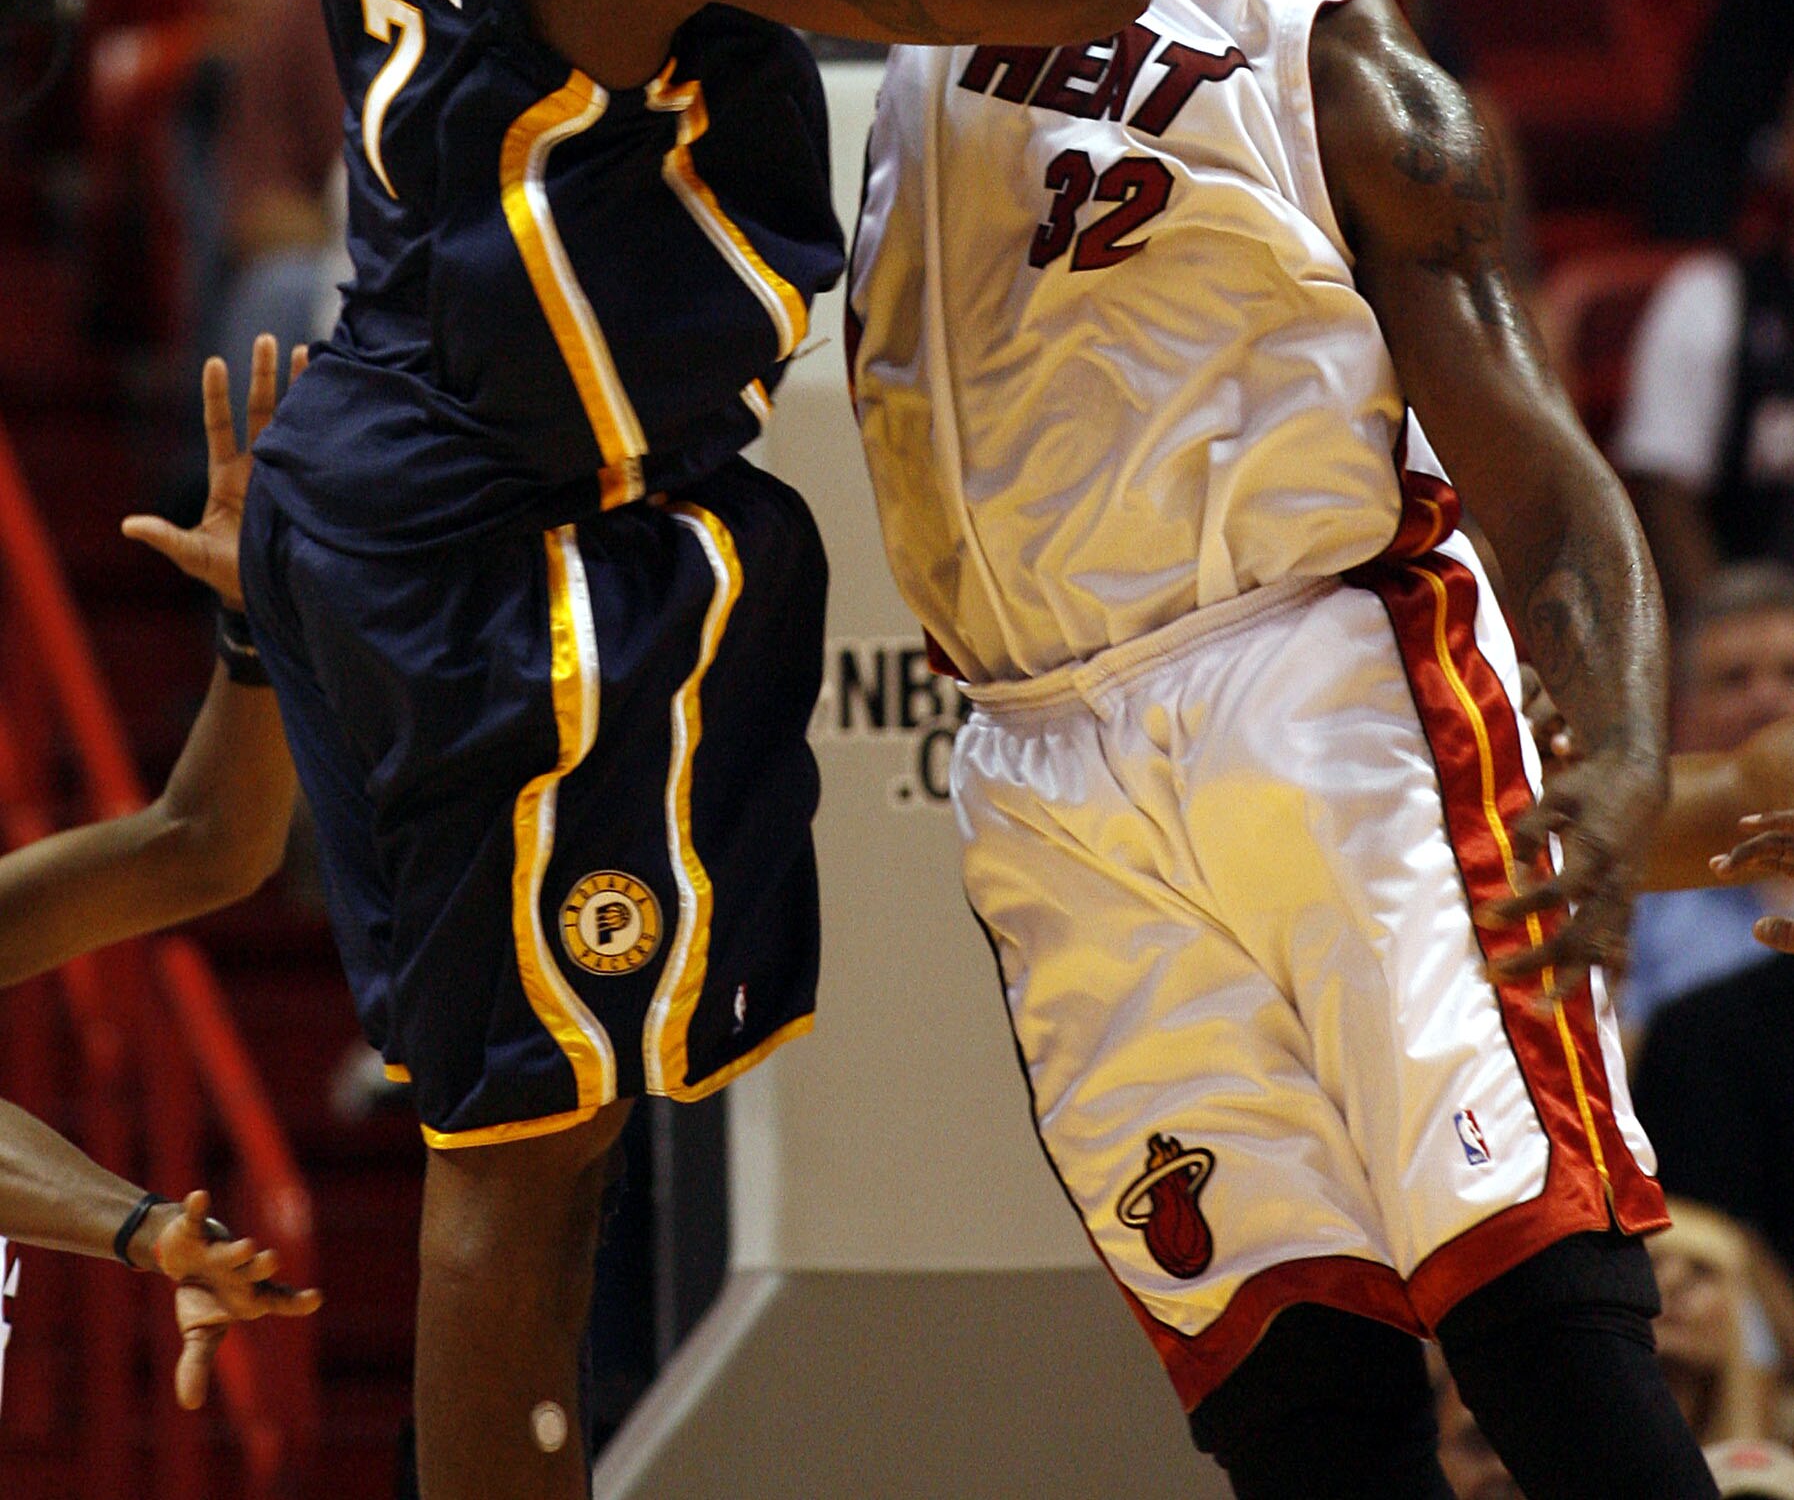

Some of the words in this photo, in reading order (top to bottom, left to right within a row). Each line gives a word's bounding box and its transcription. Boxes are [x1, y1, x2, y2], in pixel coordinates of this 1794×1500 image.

[957, 22, 1253, 137] HEAT
[1028, 147, 1175, 273] 32
[838, 648, 973, 730] NB
